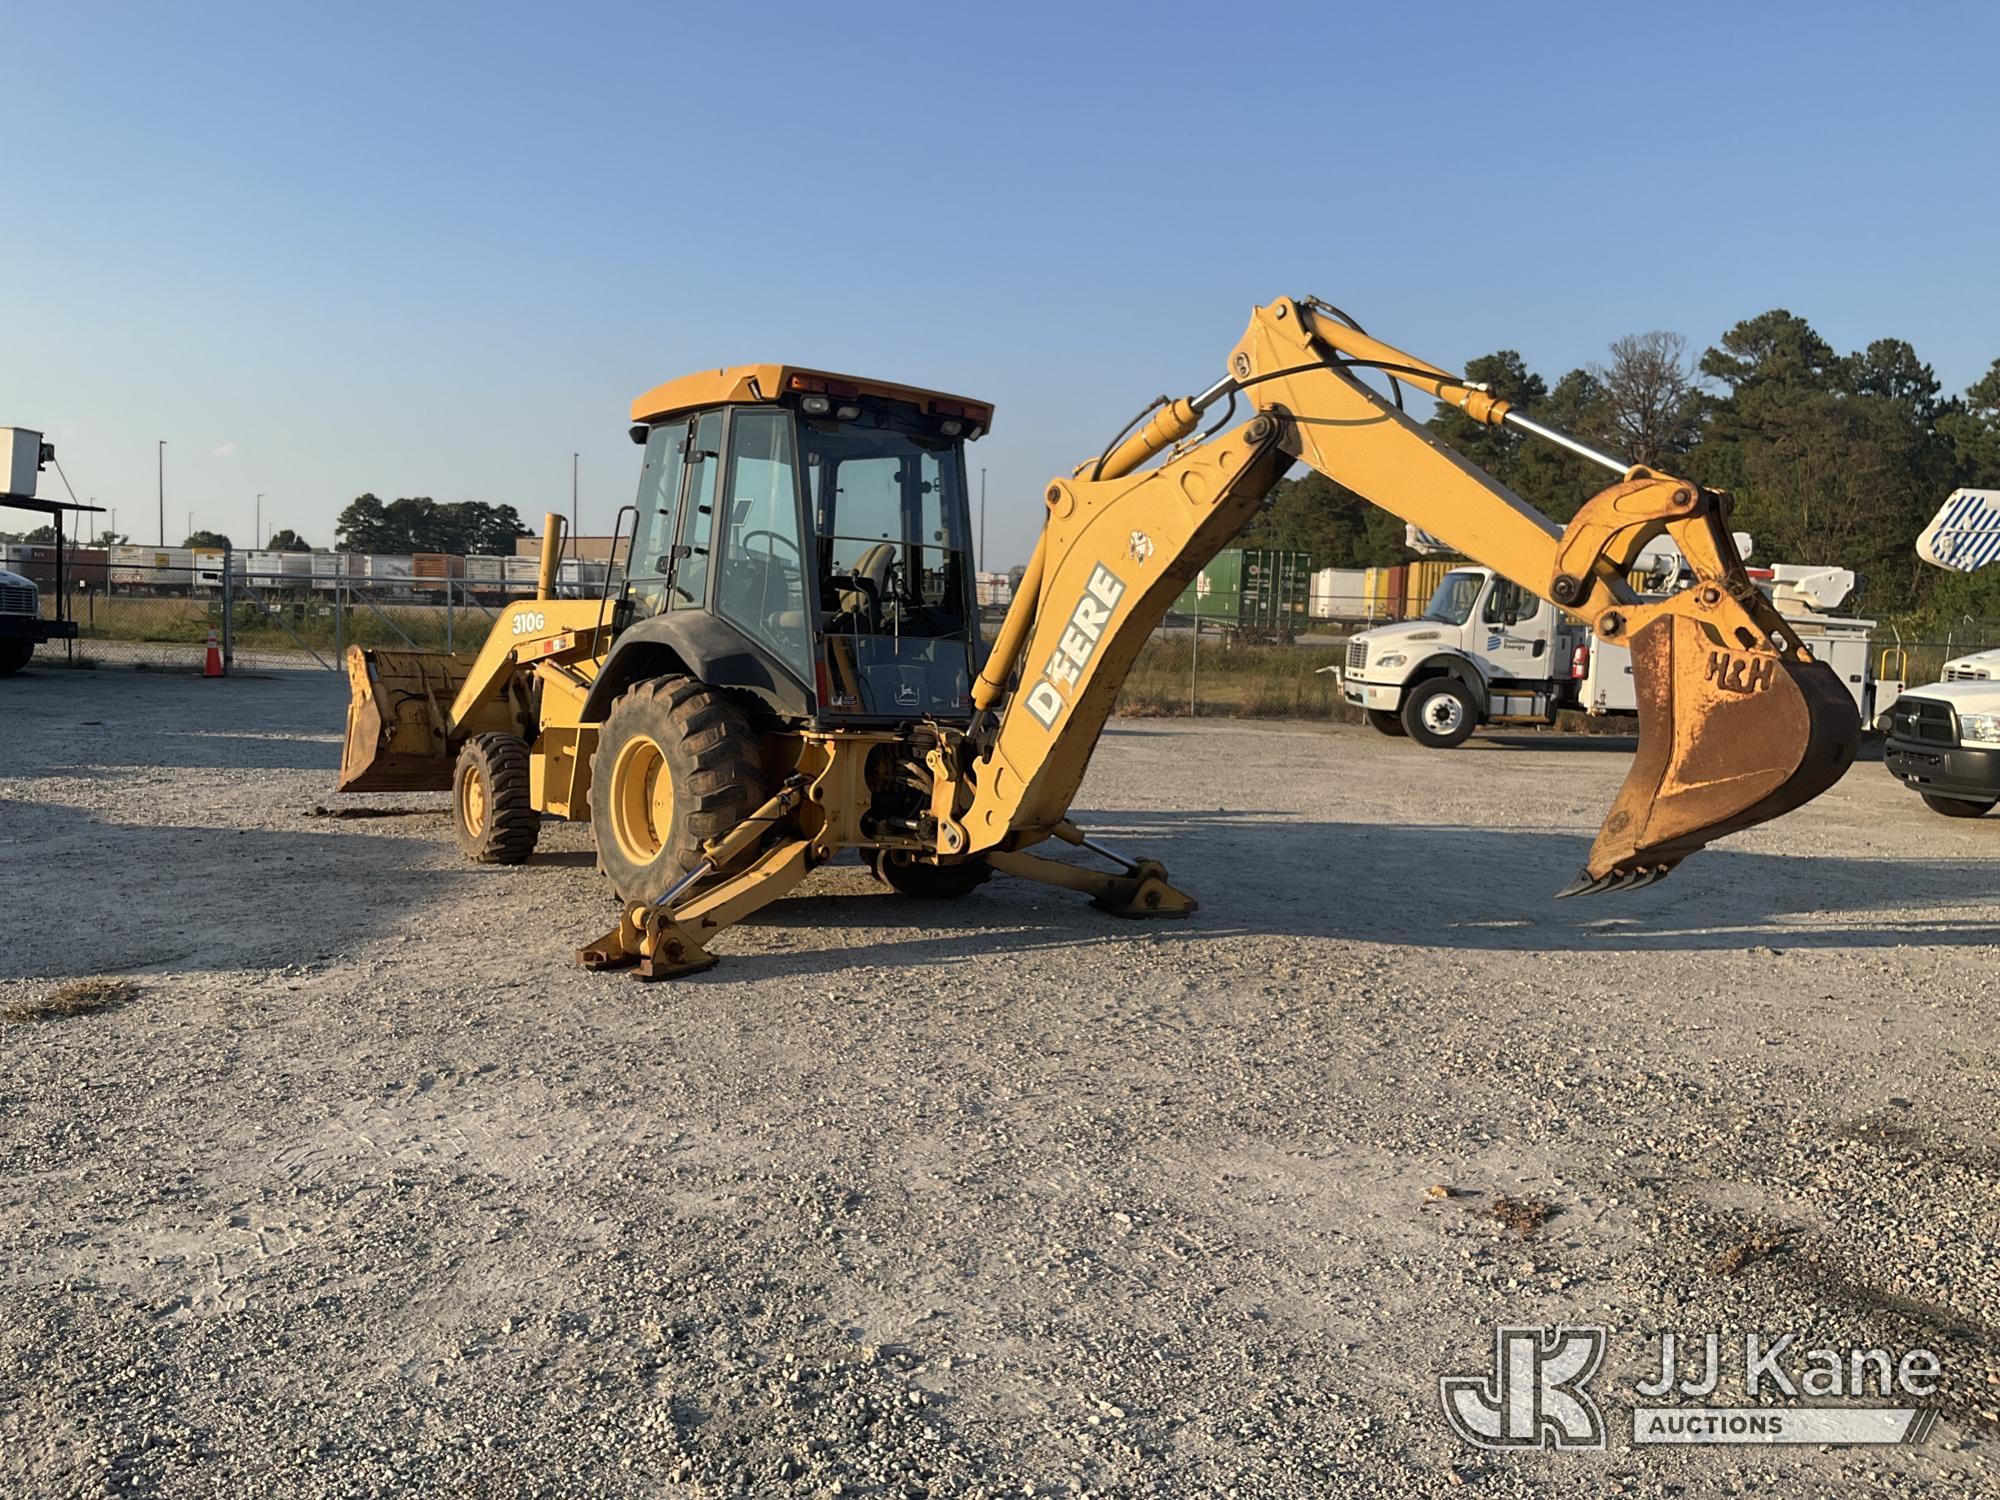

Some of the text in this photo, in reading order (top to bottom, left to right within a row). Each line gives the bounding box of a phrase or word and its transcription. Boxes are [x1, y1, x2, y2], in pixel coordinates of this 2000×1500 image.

[512, 611, 545, 635] 310G
[1026, 563, 1125, 728] DEERE
[1705, 651, 1773, 693] H&H
